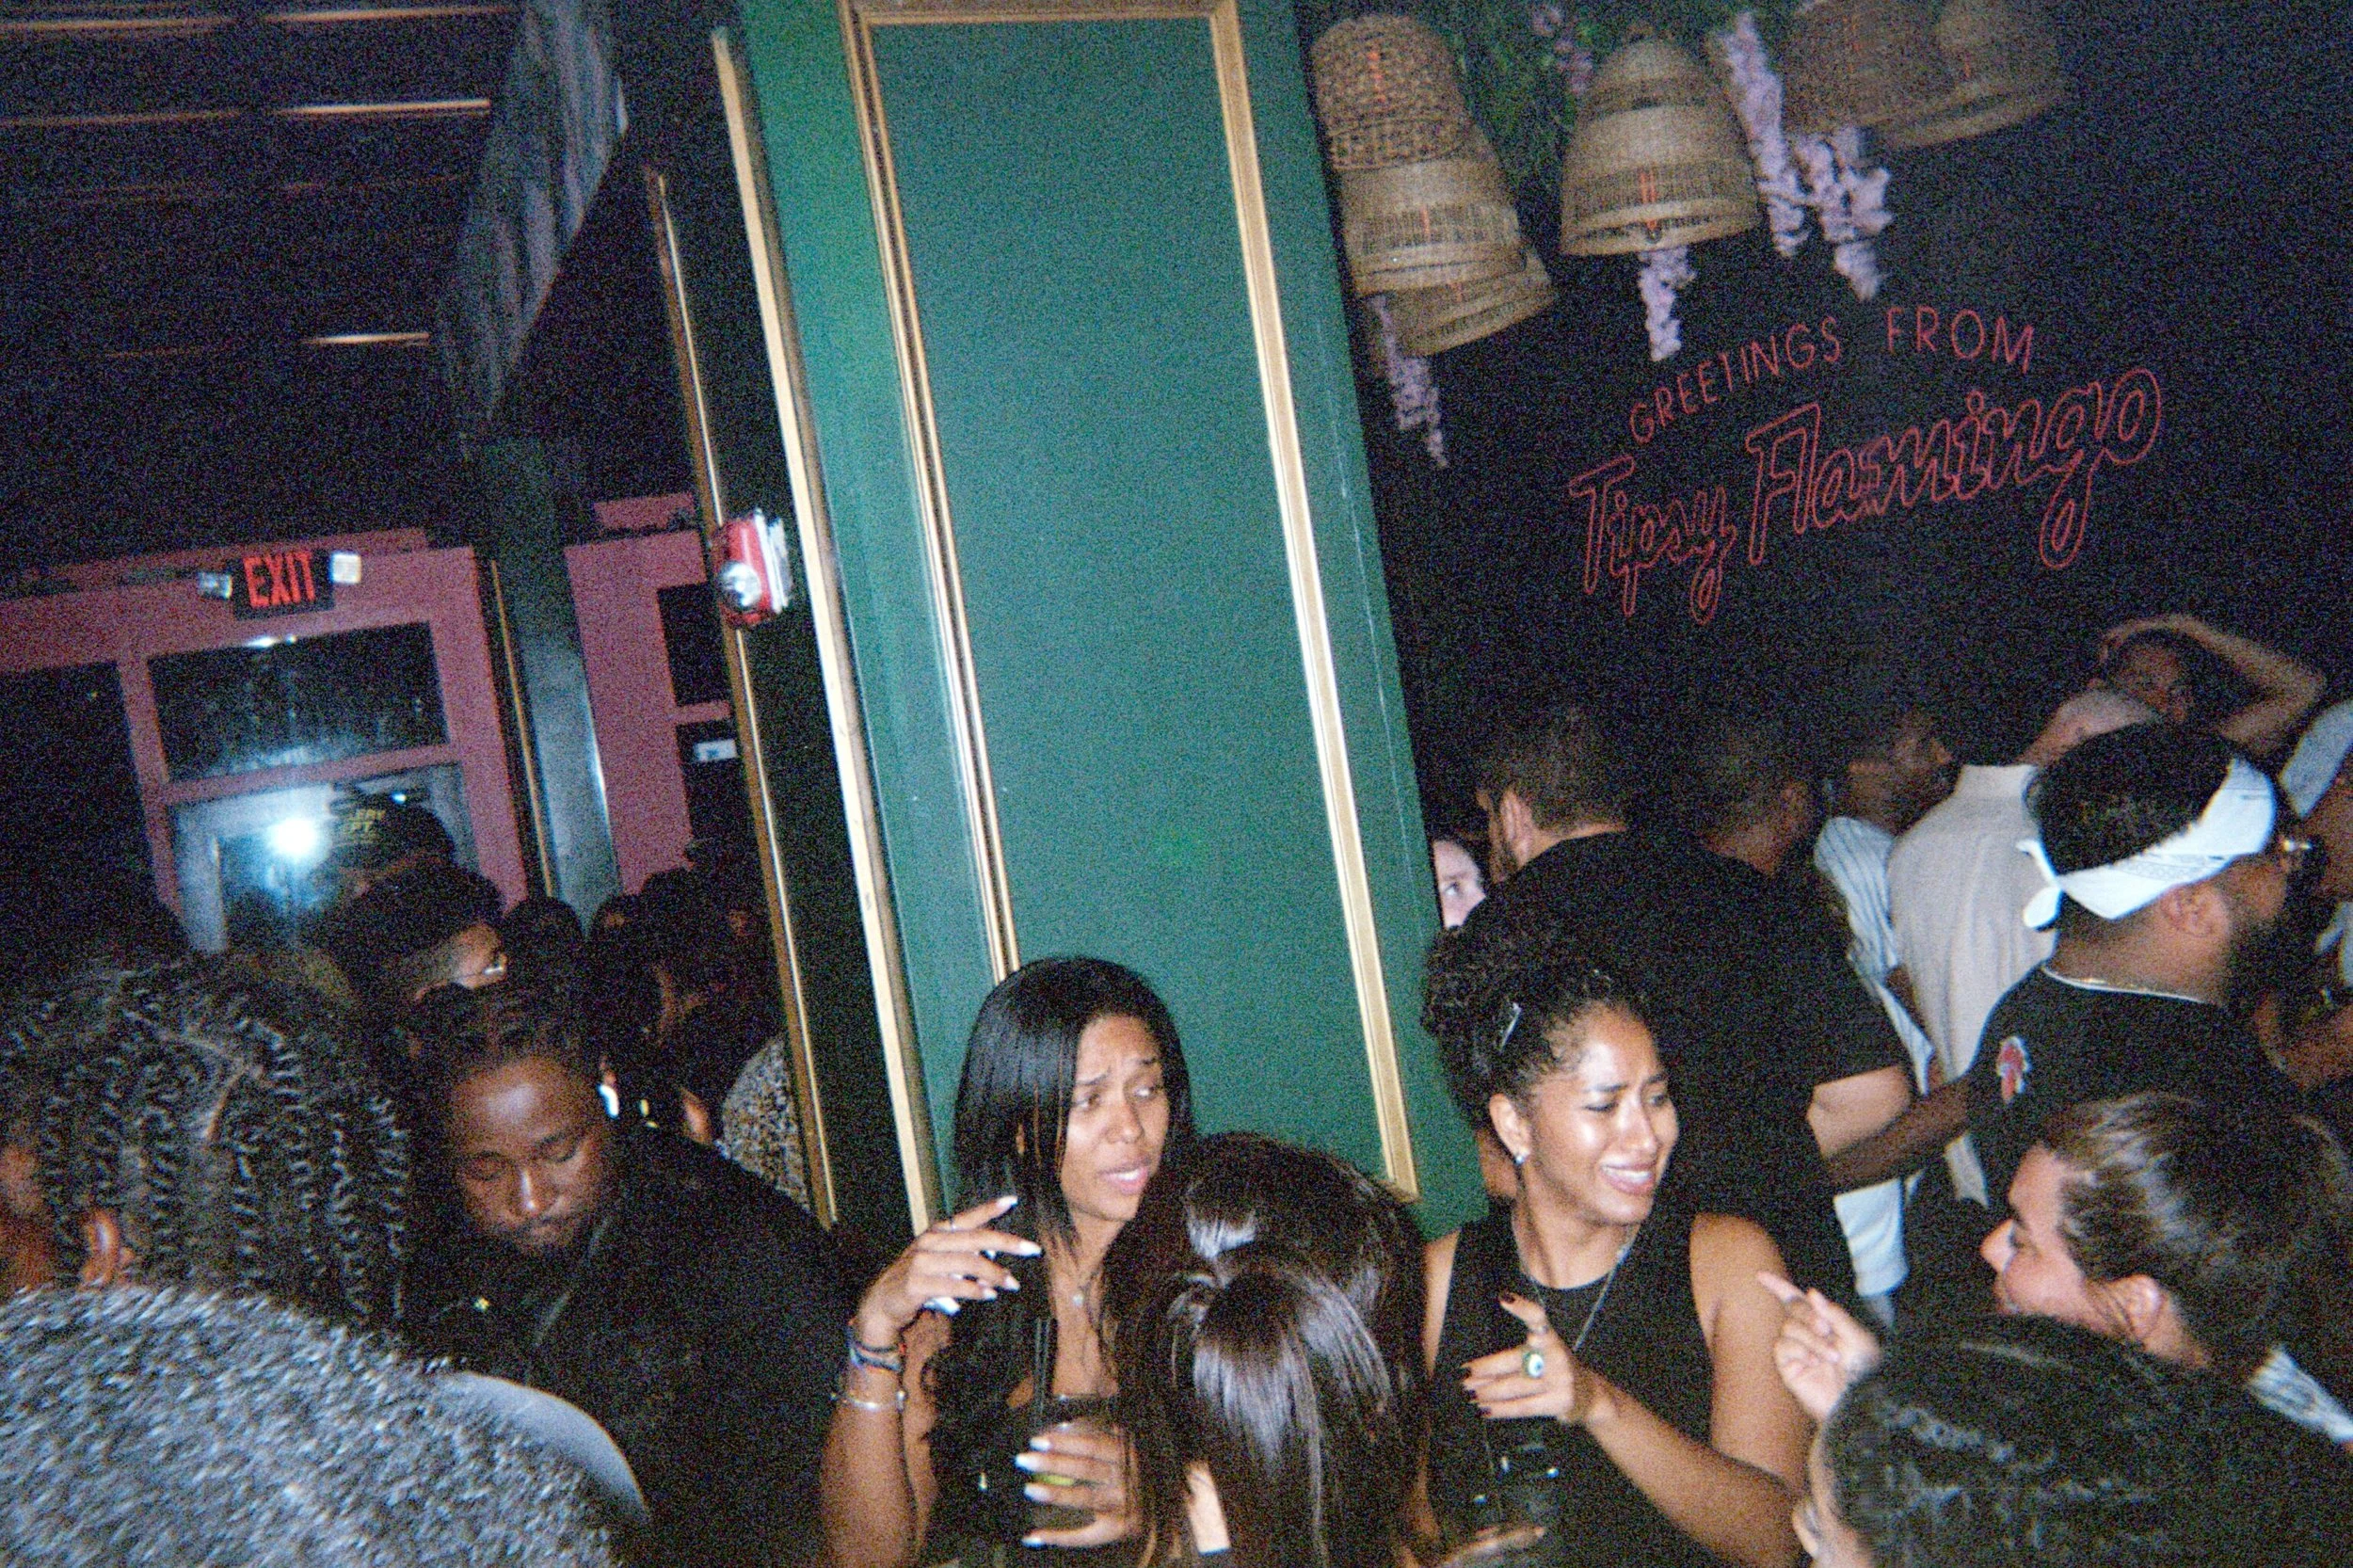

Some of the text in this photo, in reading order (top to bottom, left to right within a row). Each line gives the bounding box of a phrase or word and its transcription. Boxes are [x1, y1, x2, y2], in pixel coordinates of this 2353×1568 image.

[1630, 305, 2035, 444] GREETINGS FROM
[1569, 368, 2161, 626] Tipsy Flamingo
[243, 552, 316, 608] EXIT
